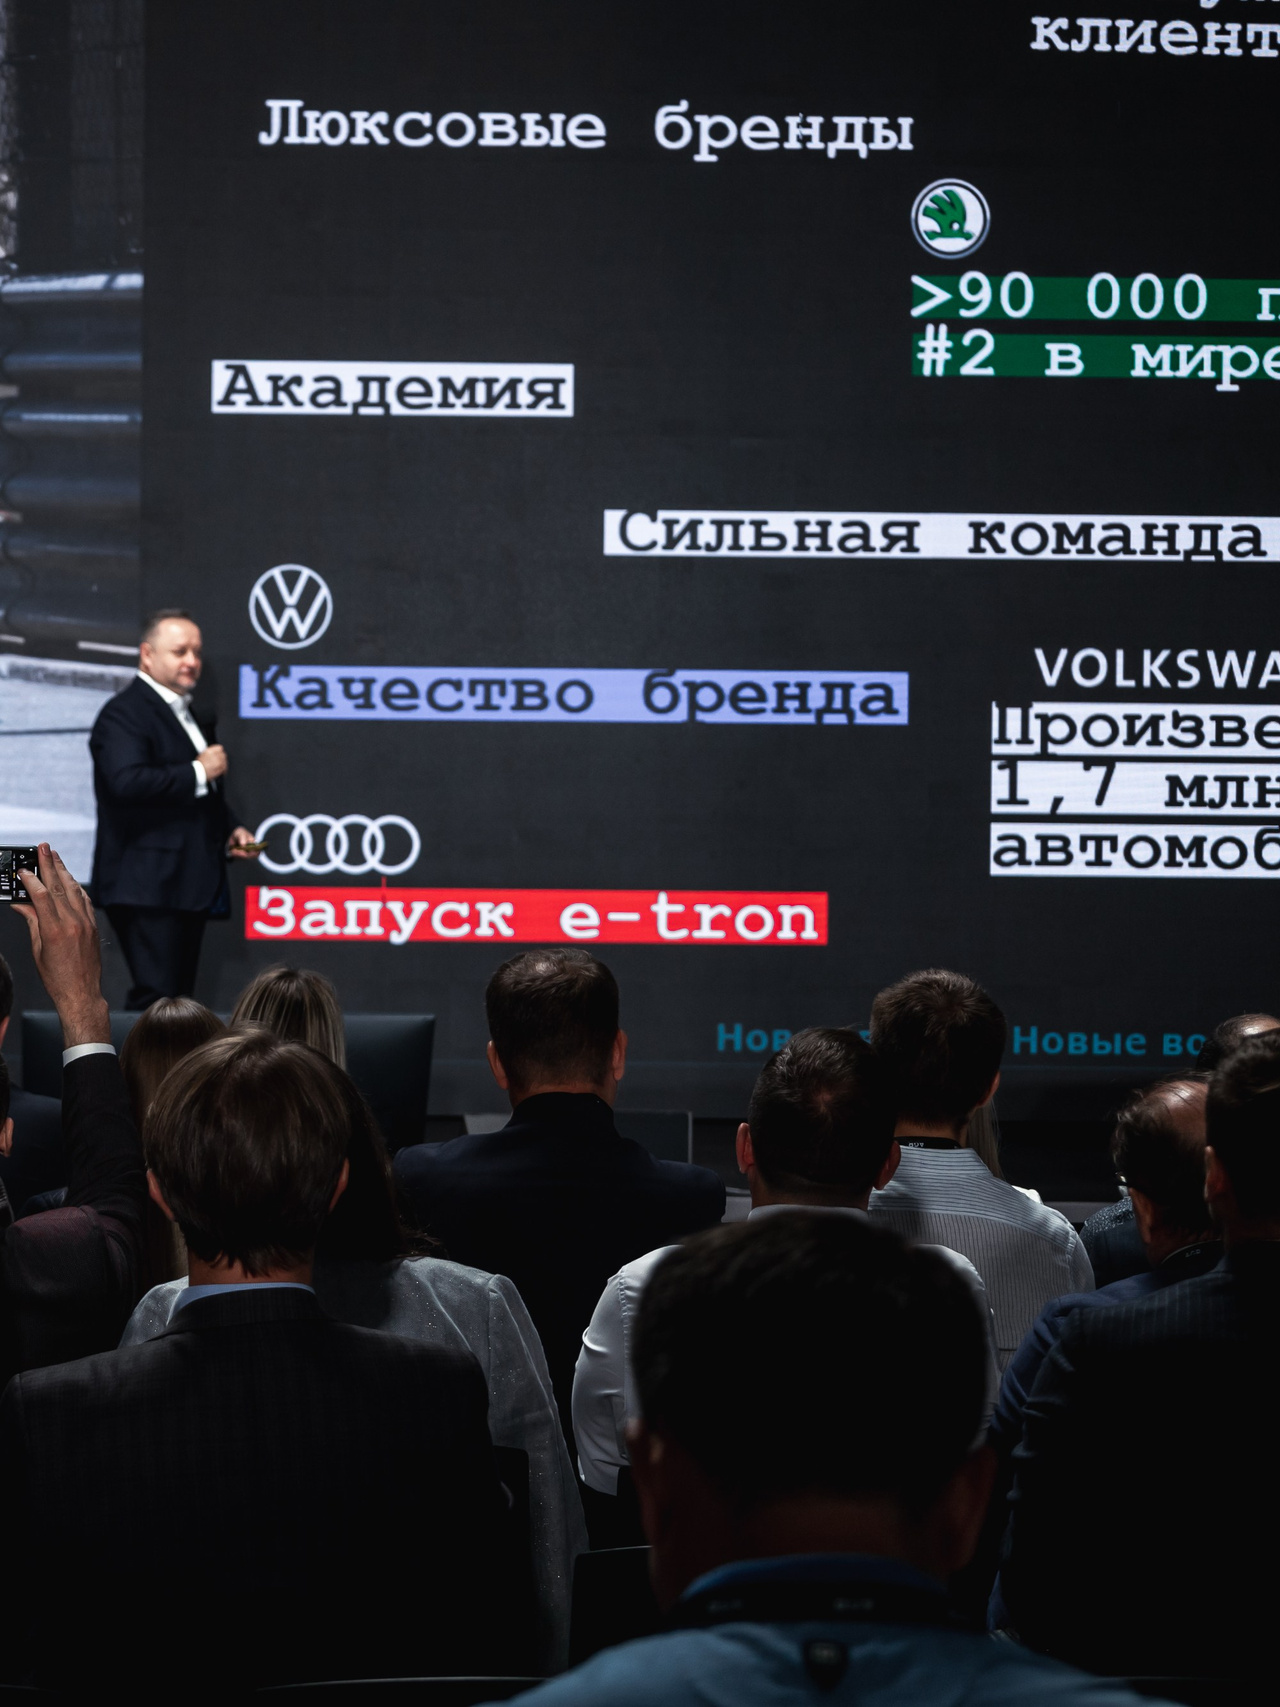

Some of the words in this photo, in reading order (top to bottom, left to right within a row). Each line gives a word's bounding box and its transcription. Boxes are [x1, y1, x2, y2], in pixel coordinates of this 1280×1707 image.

[258, 99, 607, 149] Люксовые
[654, 99, 915, 162] бренды
[910, 271, 1035, 319] >90
[1086, 272, 1208, 321] 000
[917, 323, 996, 377] #2
[1045, 342, 1085, 377] в
[217, 364, 567, 414] Академия
[619, 510, 921, 554] Сильная
[967, 521, 1268, 562] команда
[250, 664, 594, 713] Качество
[643, 669, 900, 725] бренда
[994, 702, 1280, 755] Произве
[996, 761, 1116, 815] 1,7
[1164, 774, 1280, 809] млн
[993, 827, 1280, 870] автомоб
[253, 887, 515, 946] Запуск
[559, 891, 820, 941] e-tron
[716, 1023, 793, 1052] Нов
[1013, 1025, 1147, 1056] Новые
